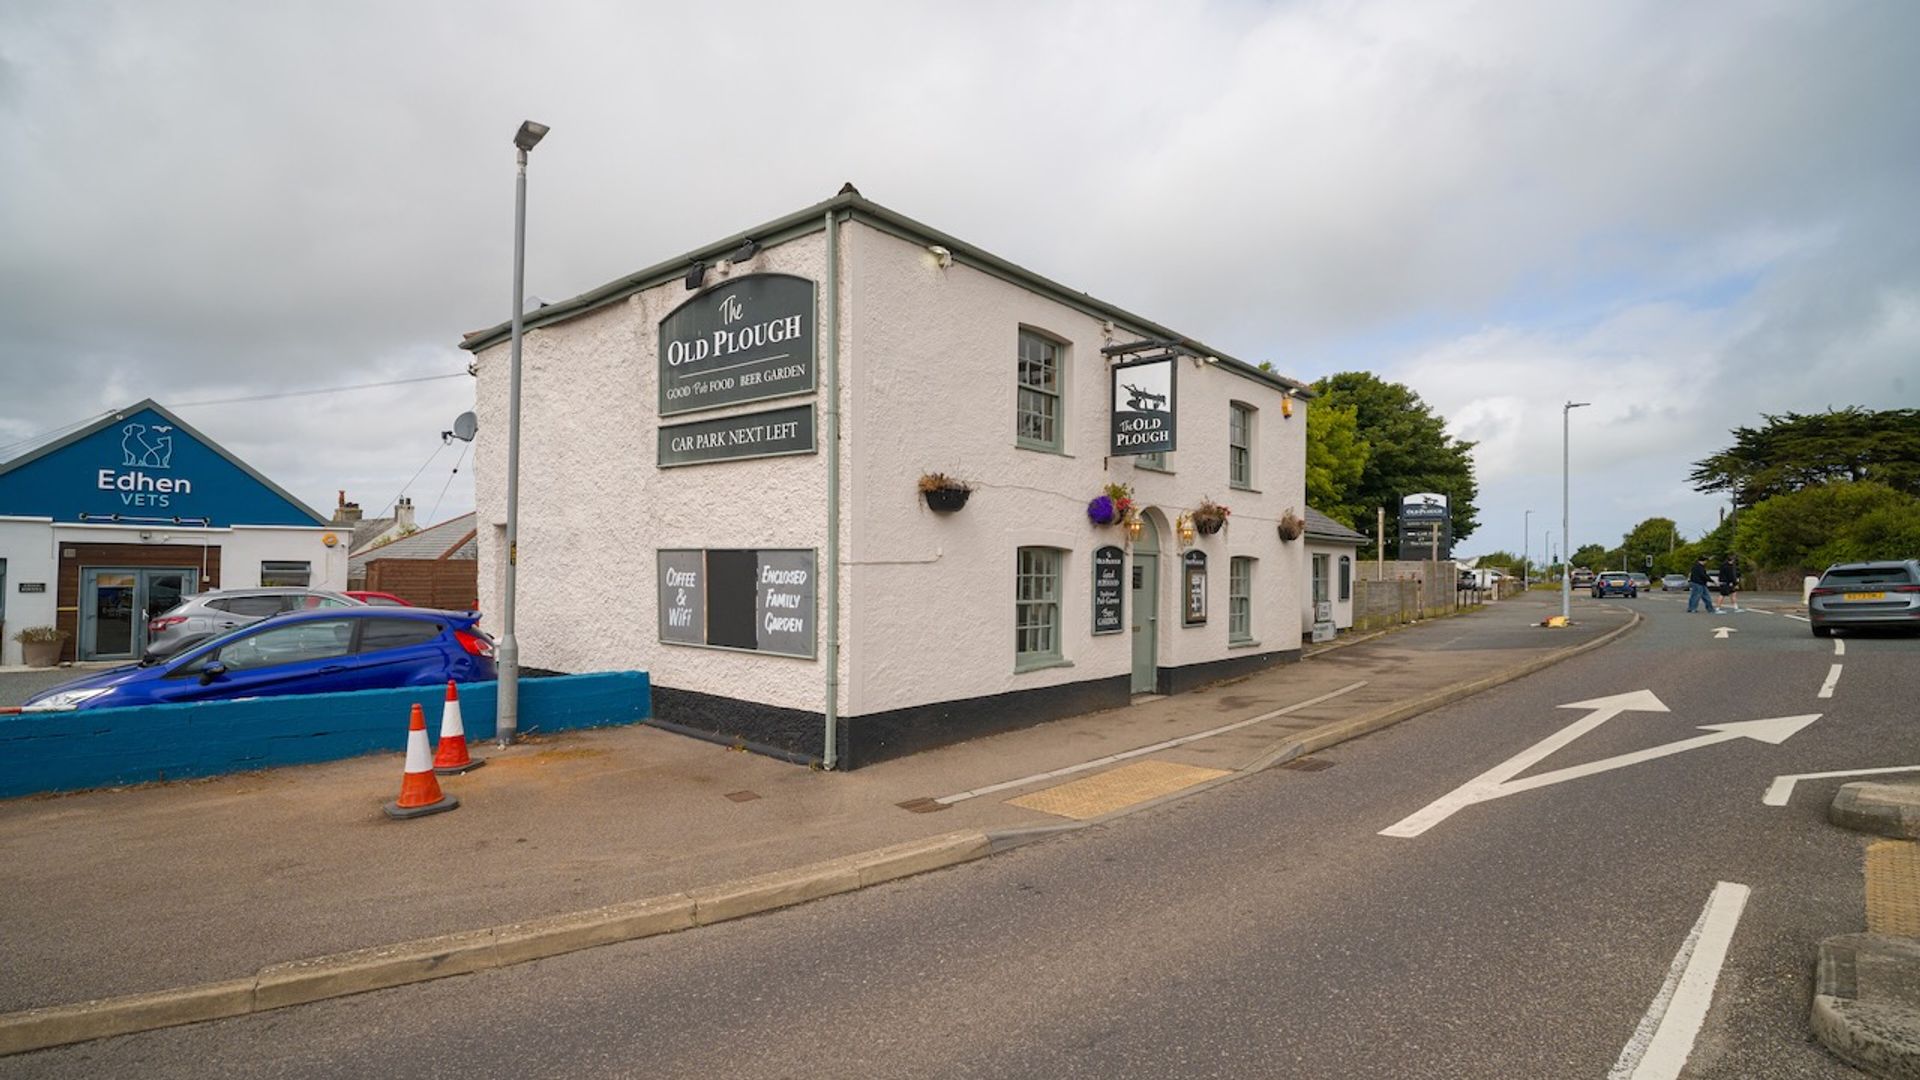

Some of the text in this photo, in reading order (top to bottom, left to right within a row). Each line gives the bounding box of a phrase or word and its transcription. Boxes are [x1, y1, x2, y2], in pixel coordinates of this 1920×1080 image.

[718, 294, 744, 326] The
[667, 314, 802, 366] OLD PLOUGH
[666, 363, 806, 400] GOOD Pub FOOD BEER GARDEN
[1119, 417, 1162, 432] The OLD
[671, 421, 798, 452] CAR PARK NEXT LEFT
[1116, 430, 1169, 447] PLOUGH
[98, 469, 191, 494] Edhen
[120, 493, 169, 508] VETS
[666, 567, 697, 588] COFFEE
[761, 565, 807, 586] ENCLOSED
[675, 587, 687, 606] &
[765, 588, 801, 609] FAMILY
[764, 611, 803, 635] GARDEN
